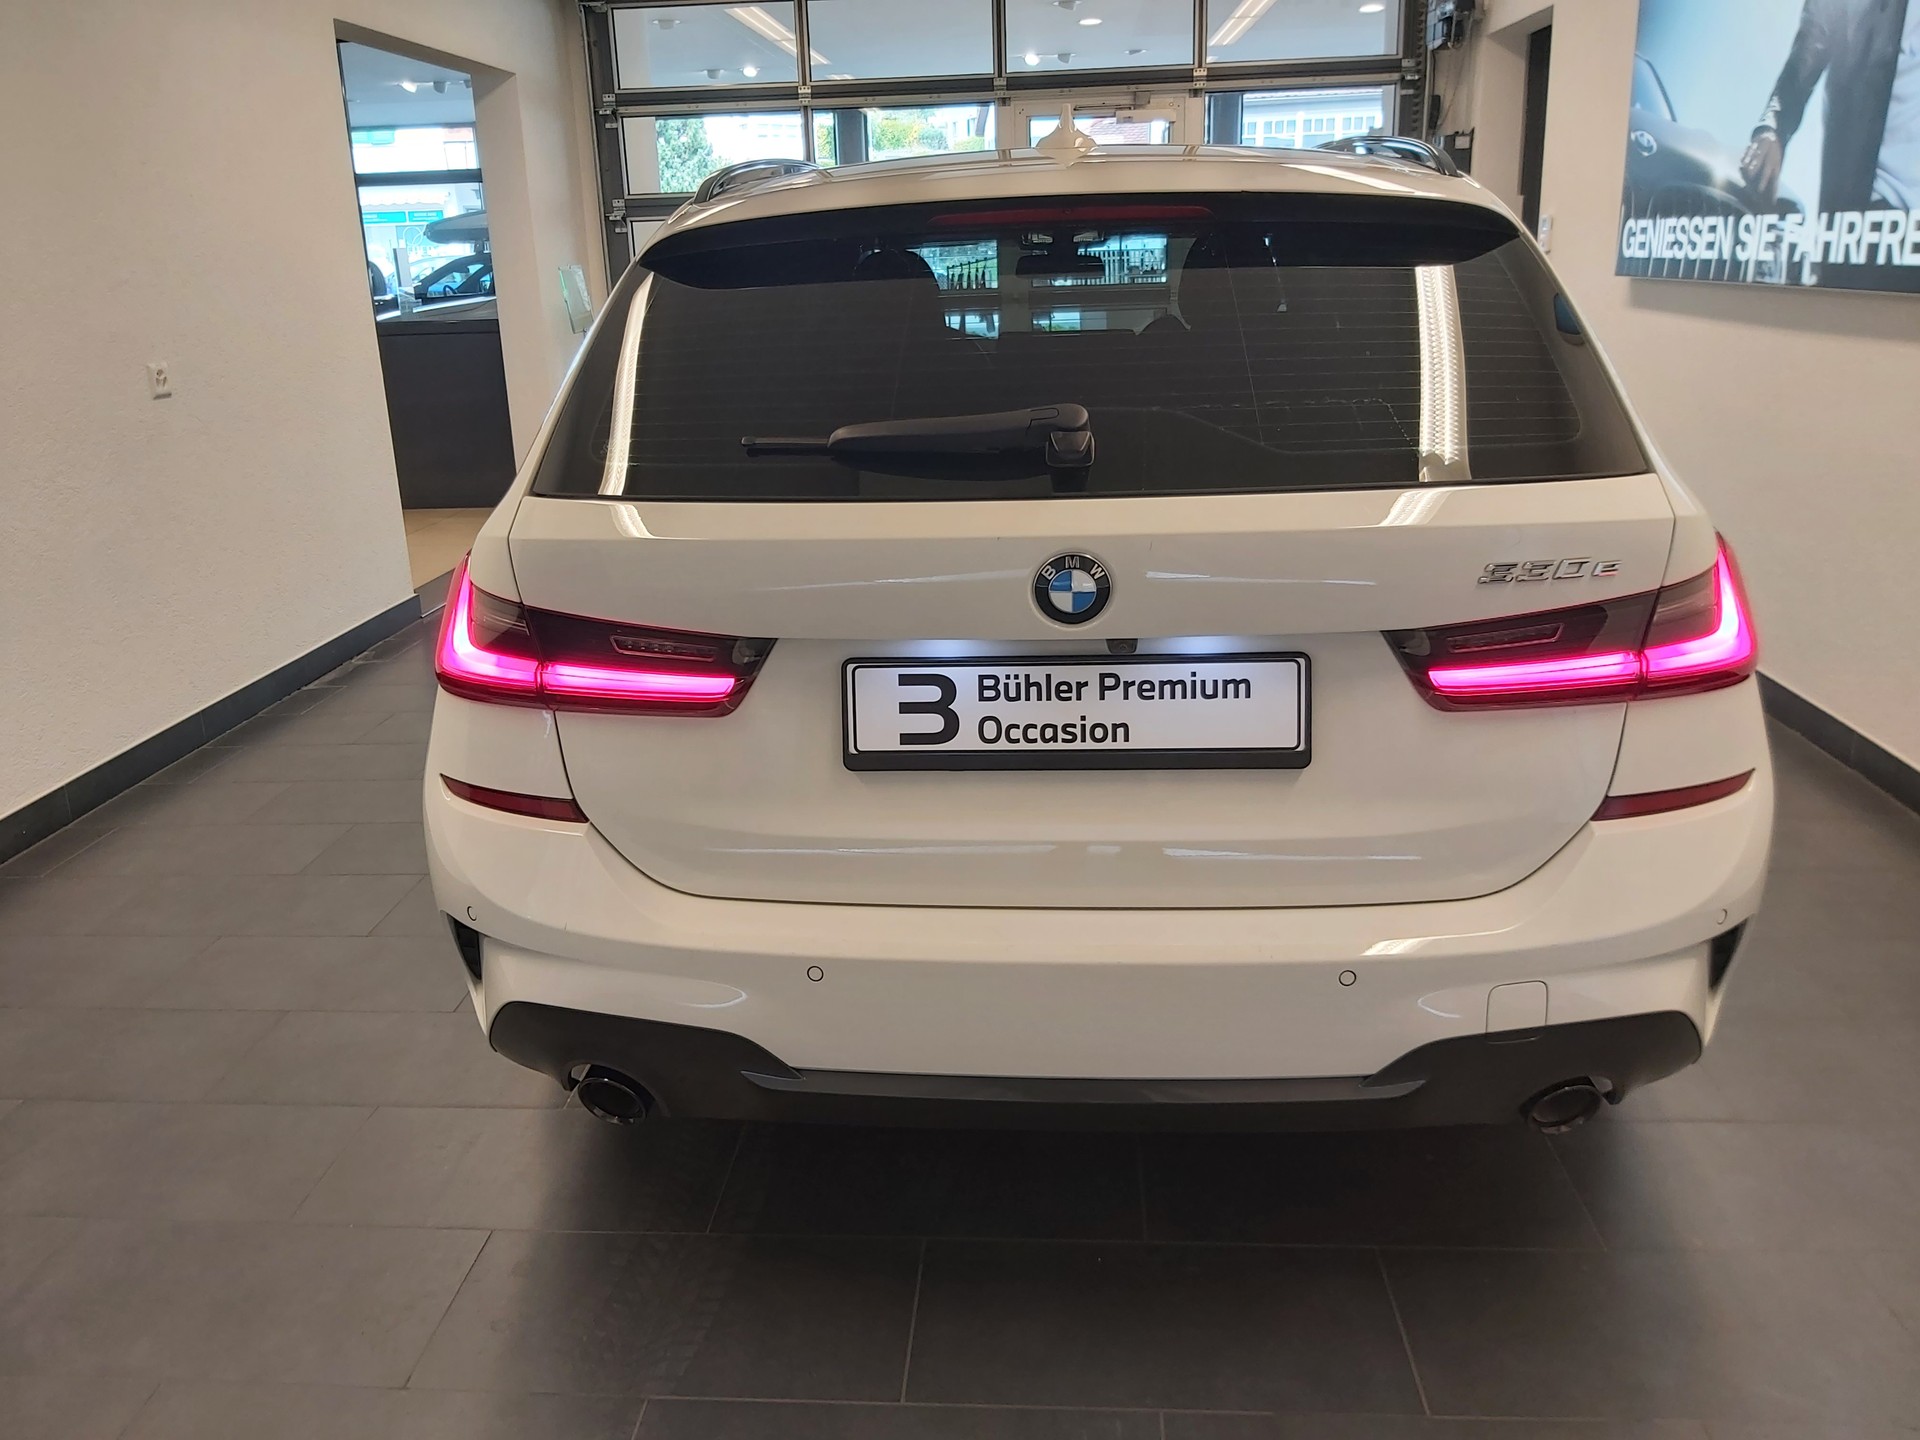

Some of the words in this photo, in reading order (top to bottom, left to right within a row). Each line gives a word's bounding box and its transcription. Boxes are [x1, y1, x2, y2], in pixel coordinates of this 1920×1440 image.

[1622, 215, 1733, 260] GENIESSEN
[1736, 214, 1776, 262] SIE
[1041, 556, 1105, 580] BMW
[978, 674, 1089, 702] Bühler
[1099, 671, 1252, 700] Premium
[977, 715, 1131, 744] Occasion
